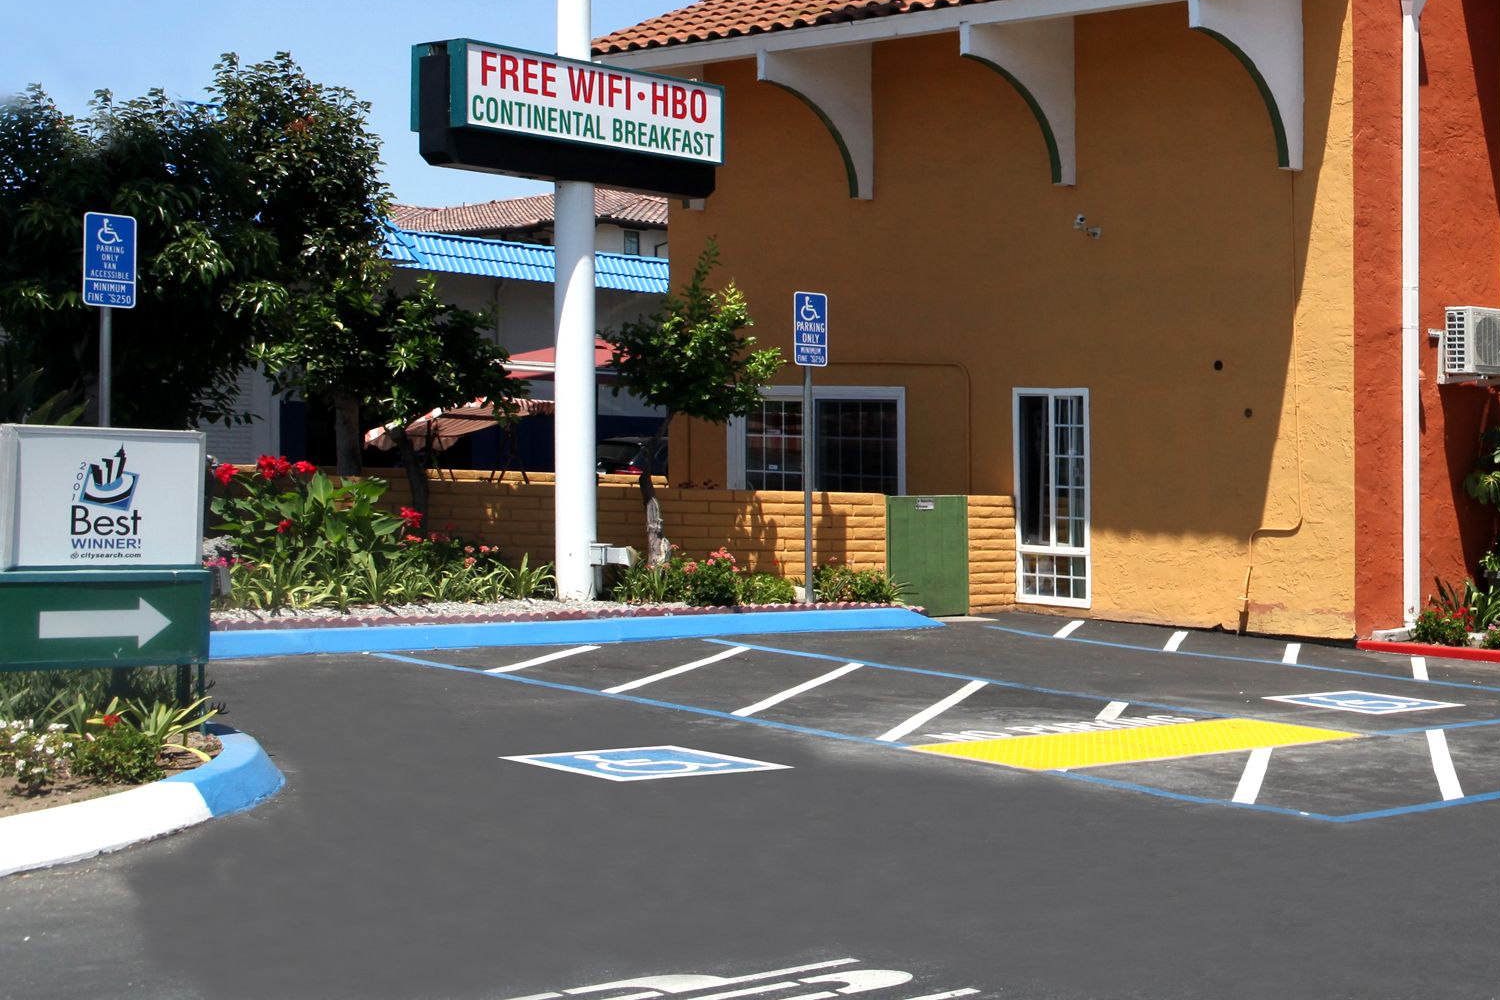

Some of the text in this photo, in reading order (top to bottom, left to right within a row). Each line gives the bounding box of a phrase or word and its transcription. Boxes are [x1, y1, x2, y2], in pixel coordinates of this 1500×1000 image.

[481, 50, 557, 98] FREE
[472, 94, 715, 157] CONTINENTAL BREAKFAST
[96, 244, 125, 254] PARKING
[101, 253, 119, 262] ONLY
[103, 262, 117, 270] VAN
[90, 270, 129, 280] ACCESSIBLE
[93, 282, 126, 293] MINIMUM
[87, 292, 104, 303] FINE
[796, 321, 825, 333] PARKING
[802, 333, 820, 344] ONLY
[70, 504, 142, 536] Best
[70, 538, 142, 549] WINNER!
[80, 551, 142, 560] citysearch.com
